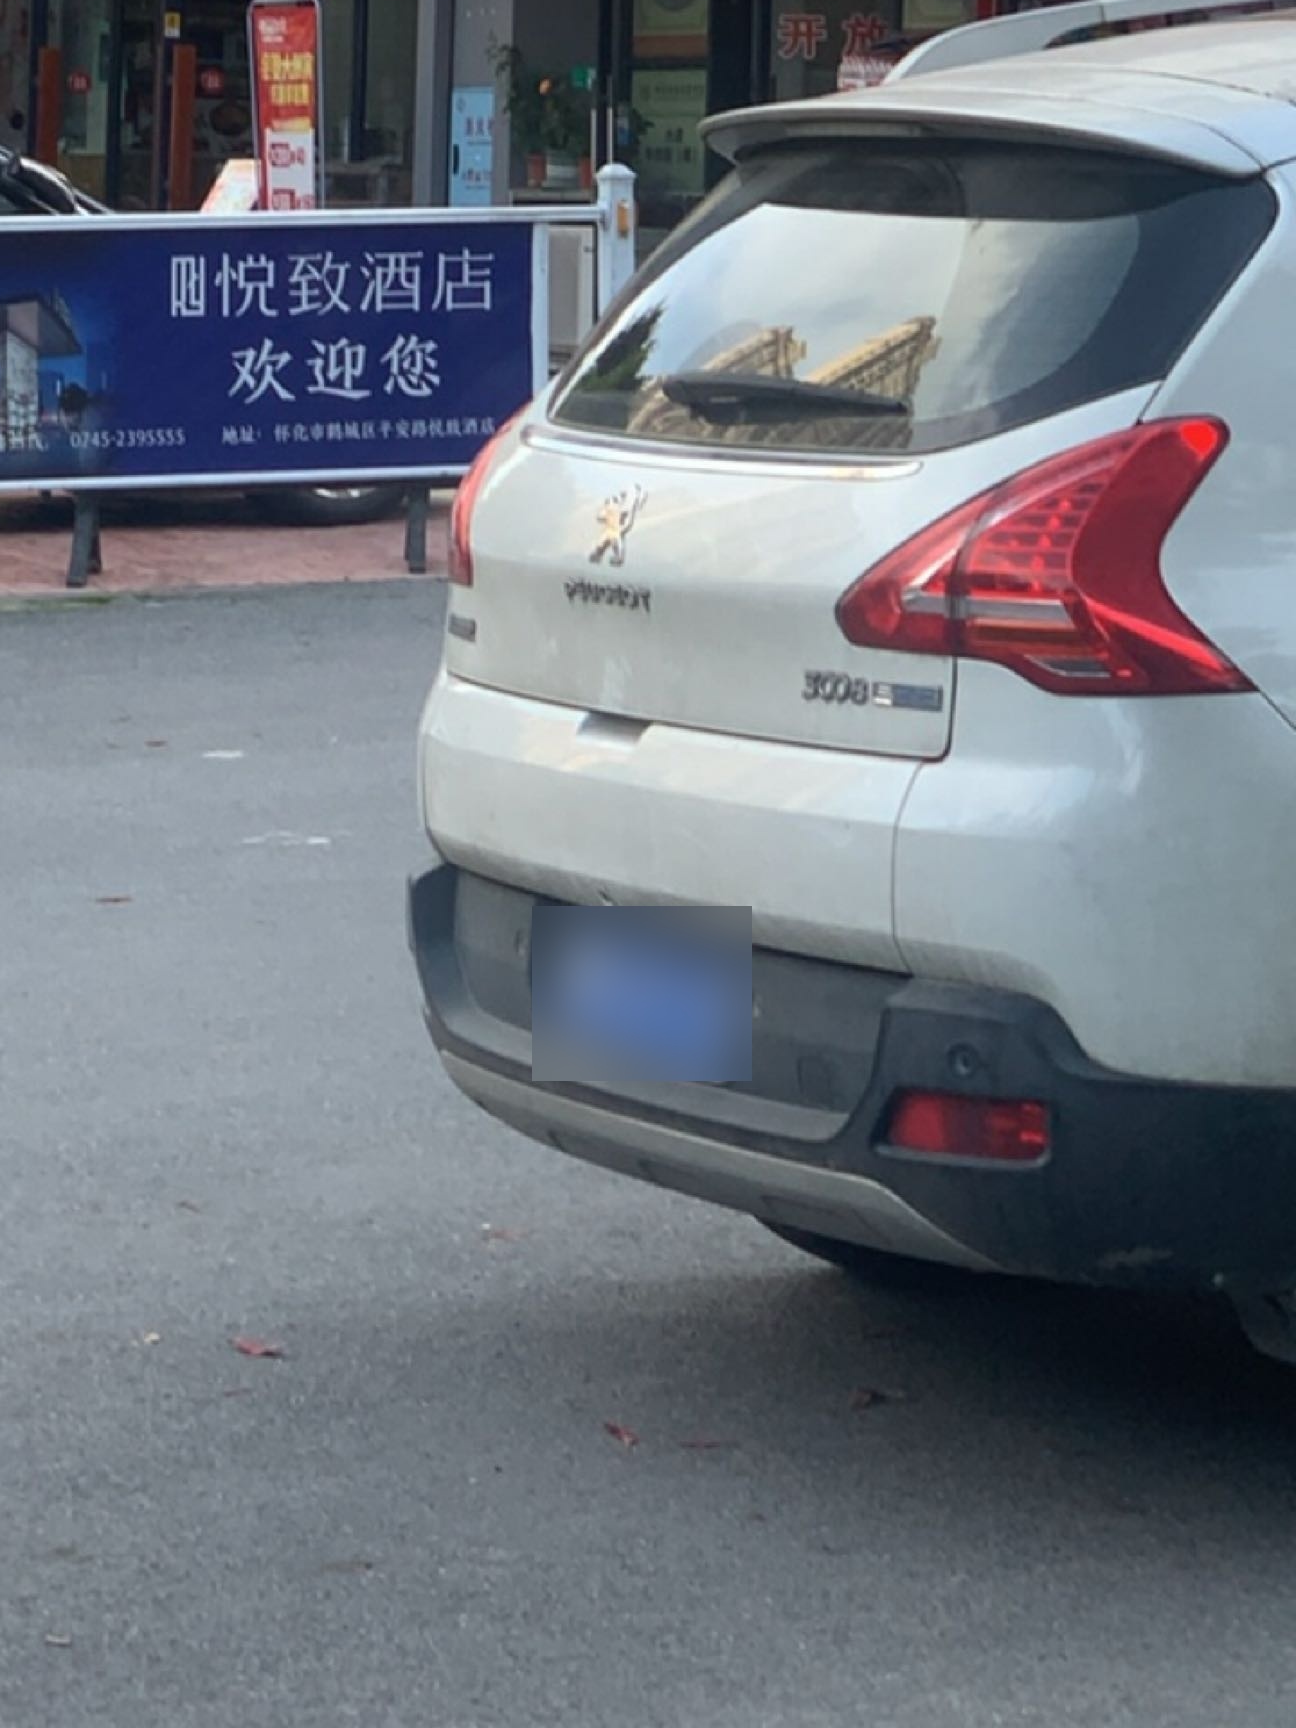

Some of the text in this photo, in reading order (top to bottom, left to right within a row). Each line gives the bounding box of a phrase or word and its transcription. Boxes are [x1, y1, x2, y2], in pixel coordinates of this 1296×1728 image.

[213, 246, 496, 318] 悦致酒店
[227, 333, 442, 405] 欢迎您
[69, 426, 186, 449] 0745-2395555
[801, 668, 869, 706] 3008
